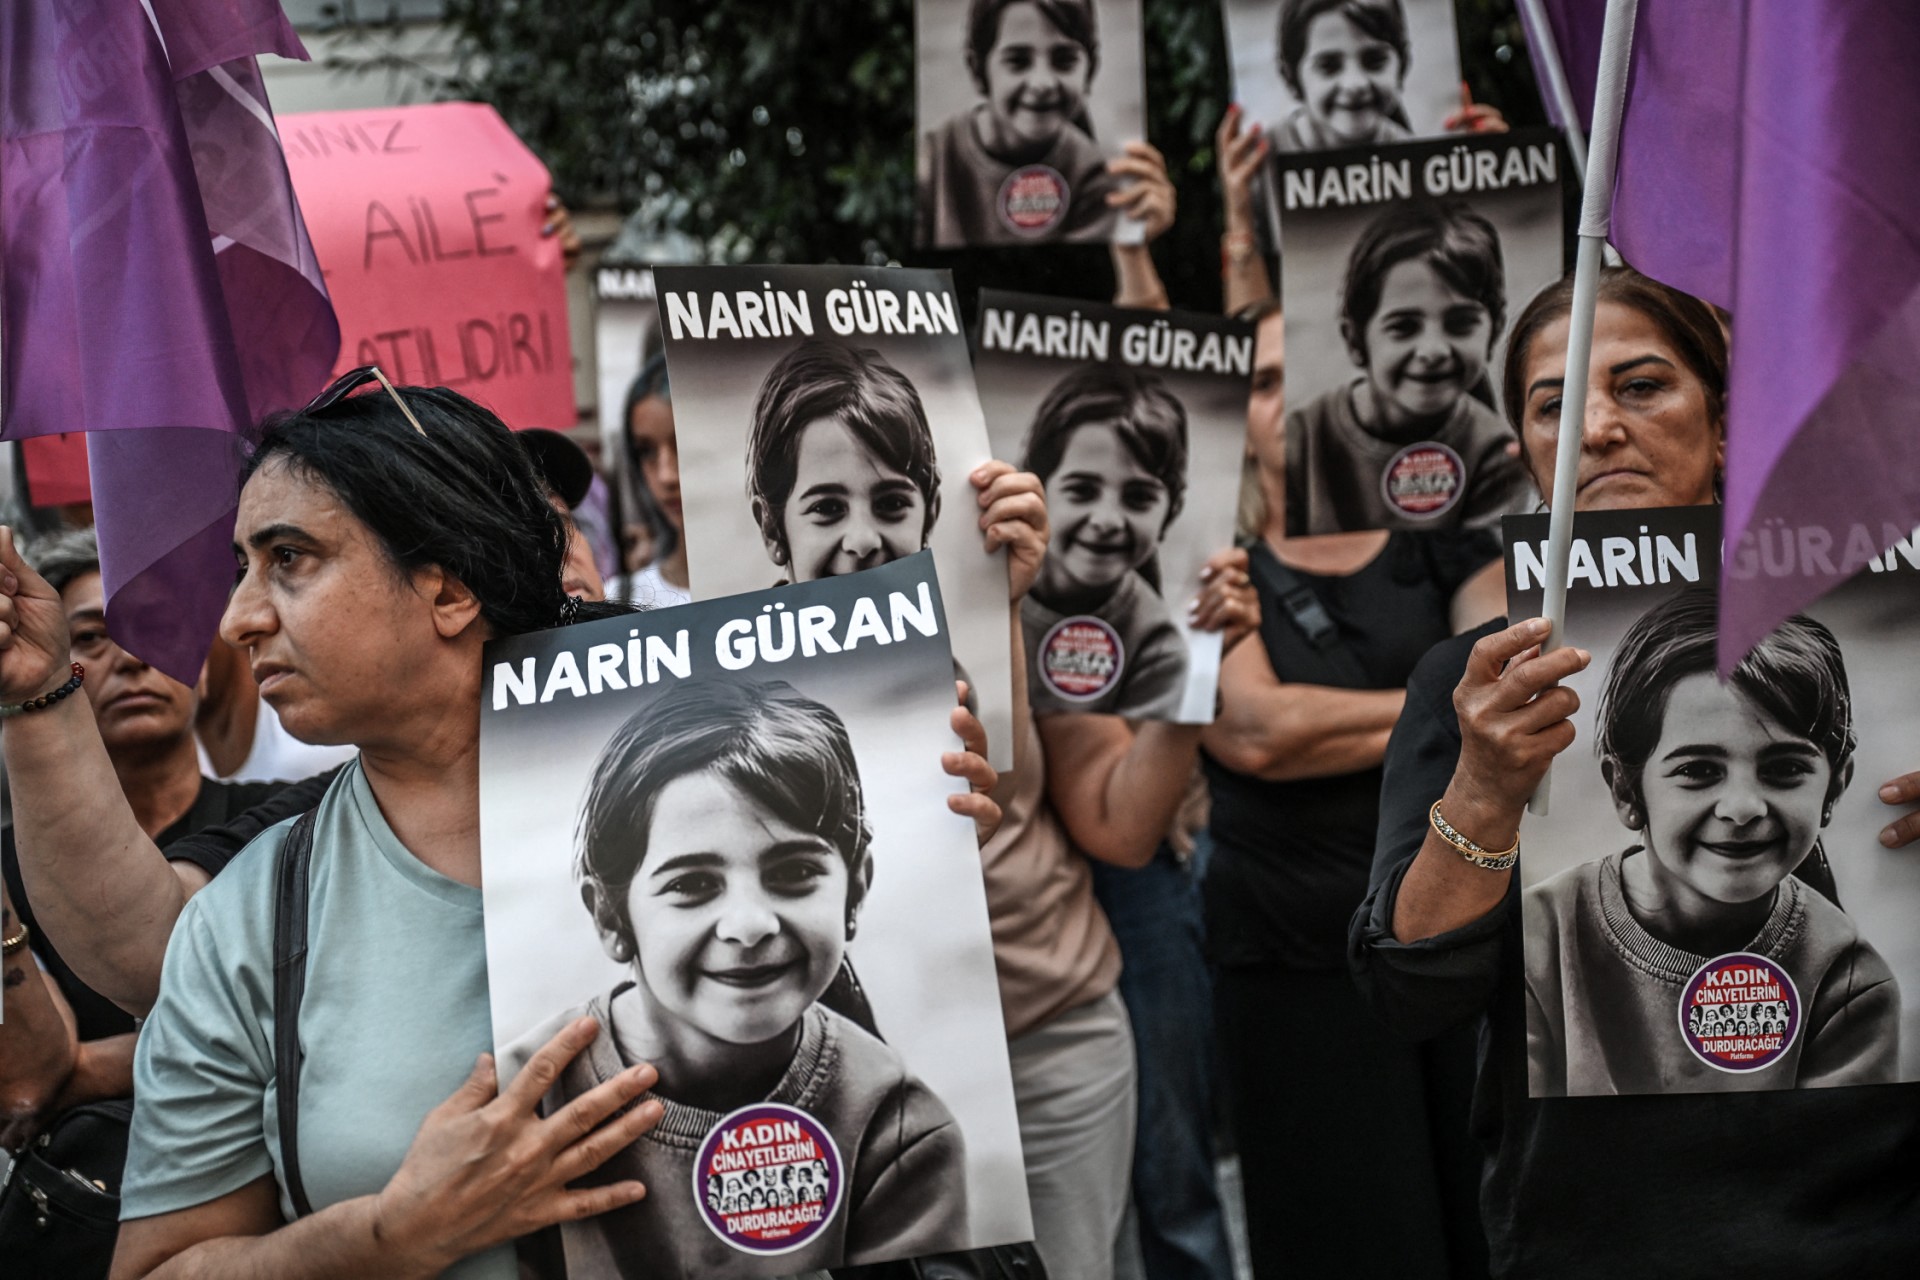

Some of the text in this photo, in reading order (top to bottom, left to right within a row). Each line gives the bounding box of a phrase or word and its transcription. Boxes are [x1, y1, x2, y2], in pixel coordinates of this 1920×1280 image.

[1283, 142, 1557, 210] NARİN GÜRAN
[665, 280, 959, 339] NARİN GÜRAN
[983, 310, 1253, 375] NARİN GÜRAN
[1513, 525, 1700, 591] NARİN
[492, 582, 939, 710] NARİN GÜRAN
[1695, 982, 1780, 1004] CİNAYETLERİNİ
[1705, 968, 1770, 987] KADIN
[1702, 1035, 1781, 1053] DURDURACAĞIZ
[722, 1120, 801, 1150] KADIN
[712, 1136, 816, 1172] CİNAYETLERİNİ
[726, 1202, 822, 1234] DURDURACAĞIZ
